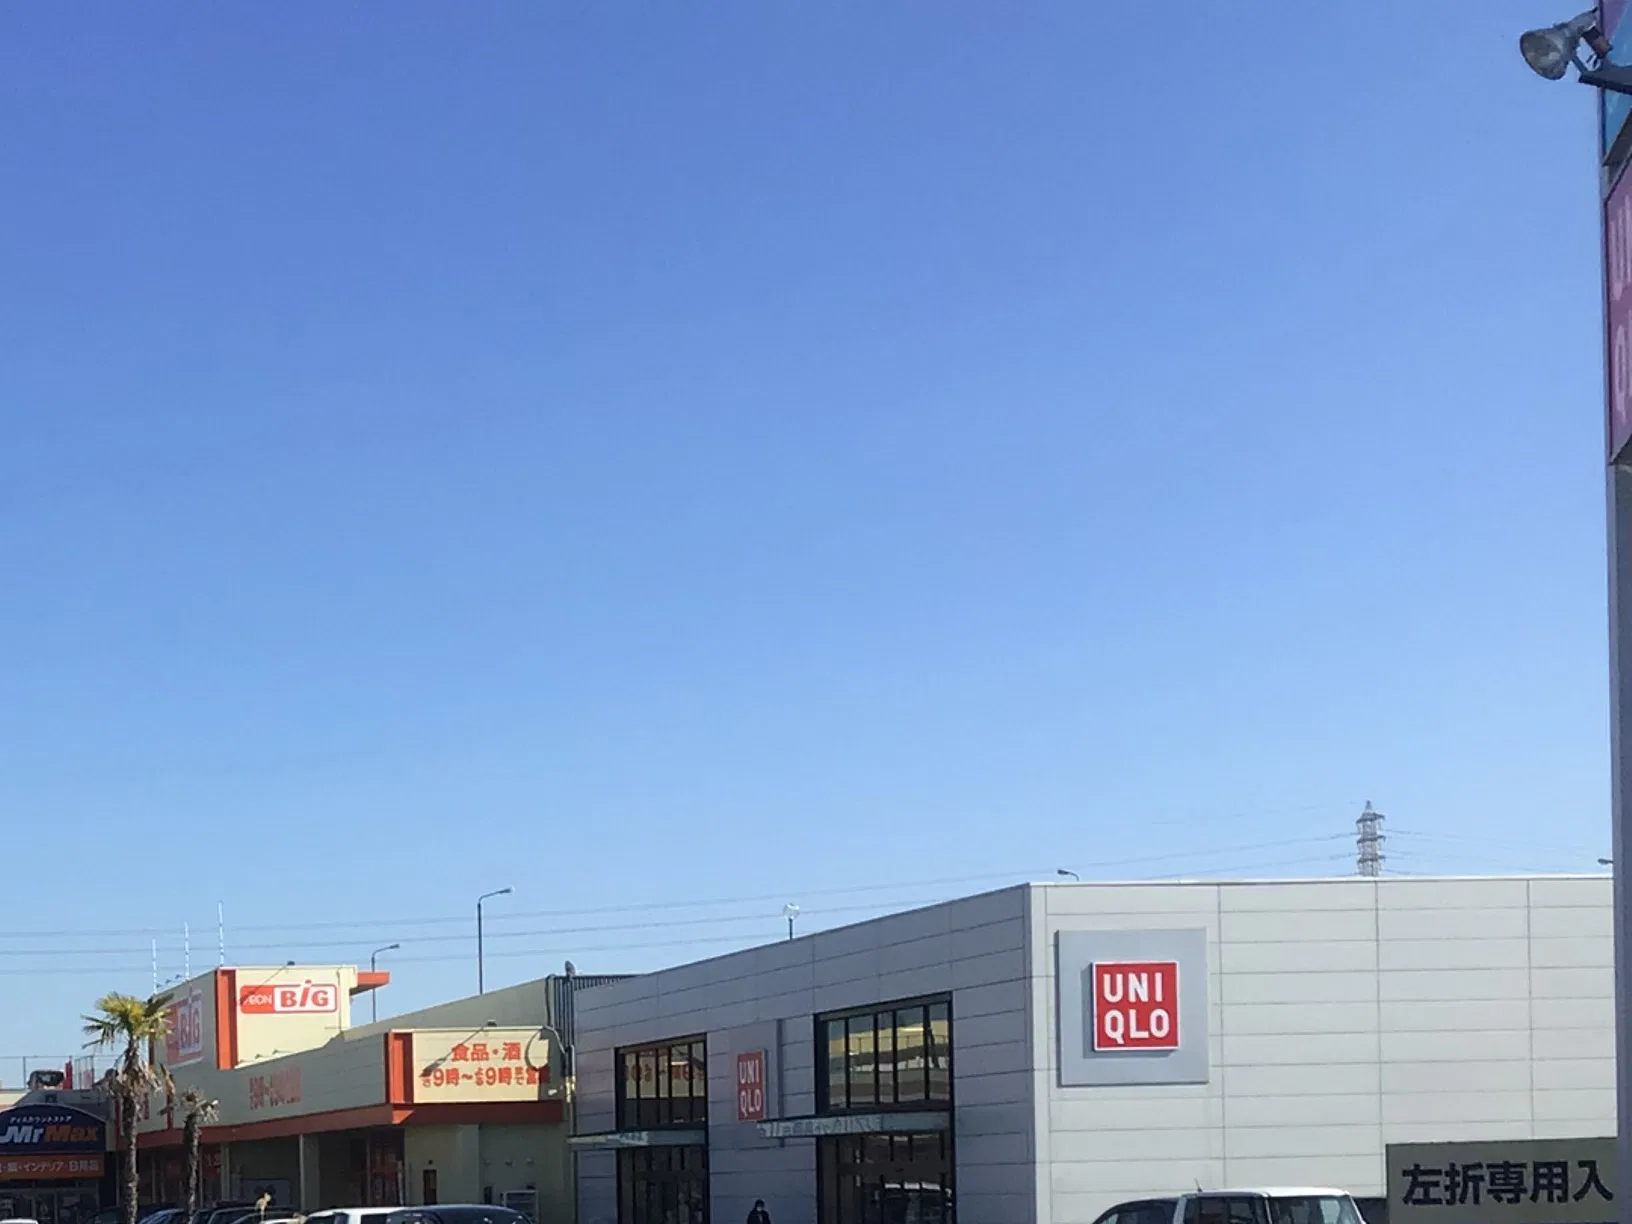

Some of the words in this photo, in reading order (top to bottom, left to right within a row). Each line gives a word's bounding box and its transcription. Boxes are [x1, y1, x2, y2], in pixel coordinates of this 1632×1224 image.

[1103, 972, 1163, 1003] UNI
[1104, 1009, 1170, 1045] QLO
[451, 1042, 521, 1062] 食品・酒
[739, 1059, 760, 1084] UNI
[740, 1090, 762, 1117] QLO
